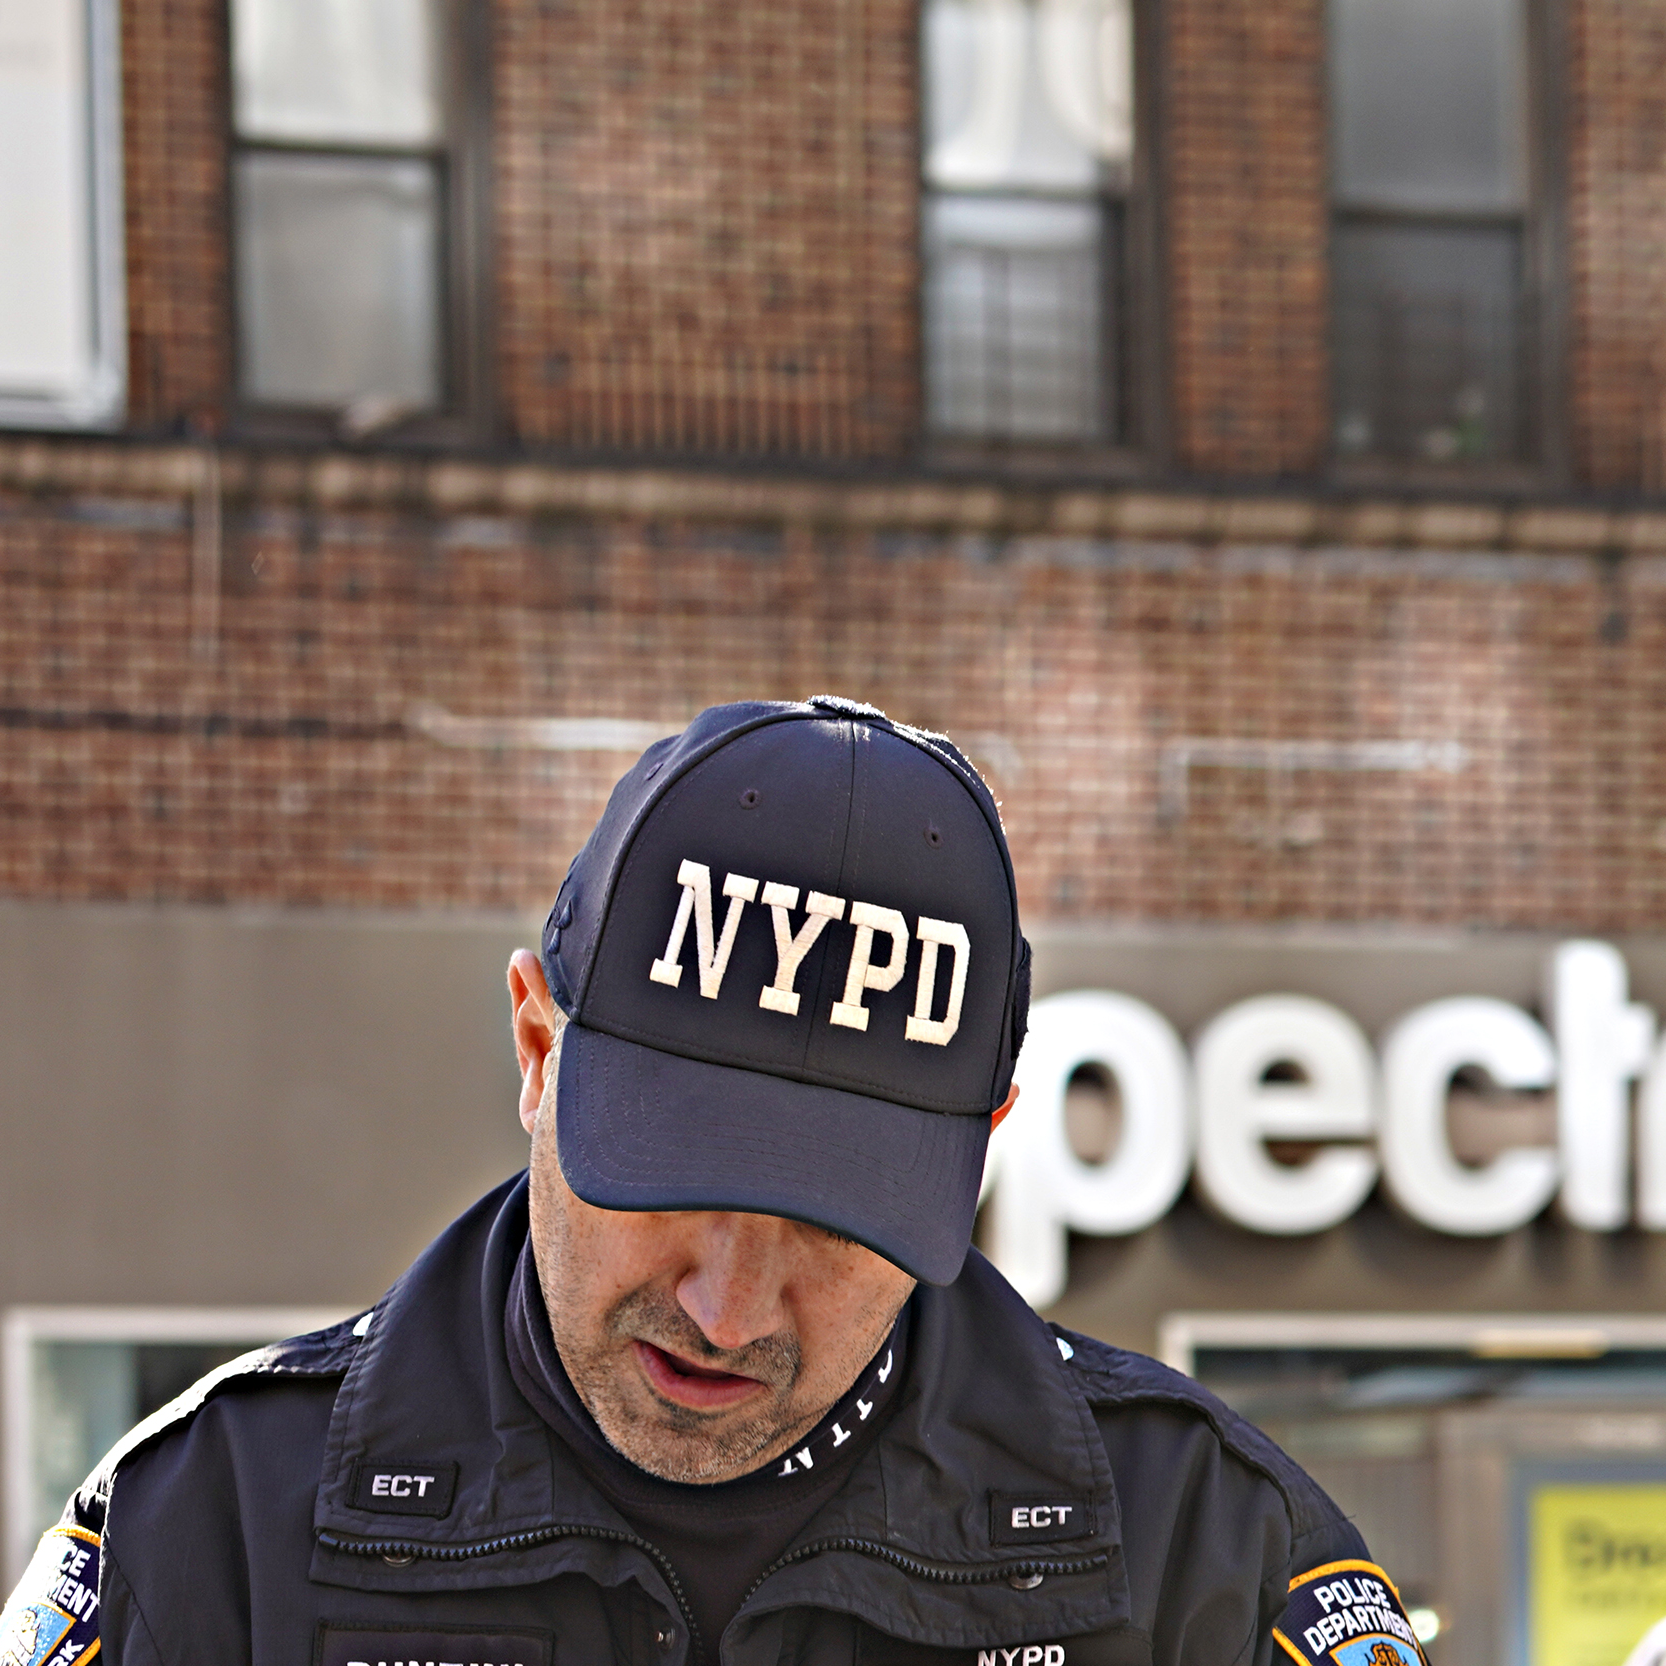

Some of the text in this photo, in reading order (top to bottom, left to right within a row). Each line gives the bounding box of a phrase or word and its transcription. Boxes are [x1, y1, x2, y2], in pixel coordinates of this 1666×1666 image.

[649, 858, 970, 1046] NYPD
[371, 1474, 435, 1498] ECT
[1011, 1505, 1073, 1529] ECT
[1313, 1577, 1392, 1615] POLICE
[1303, 1604, 1419, 1656] DEPARTMEN
